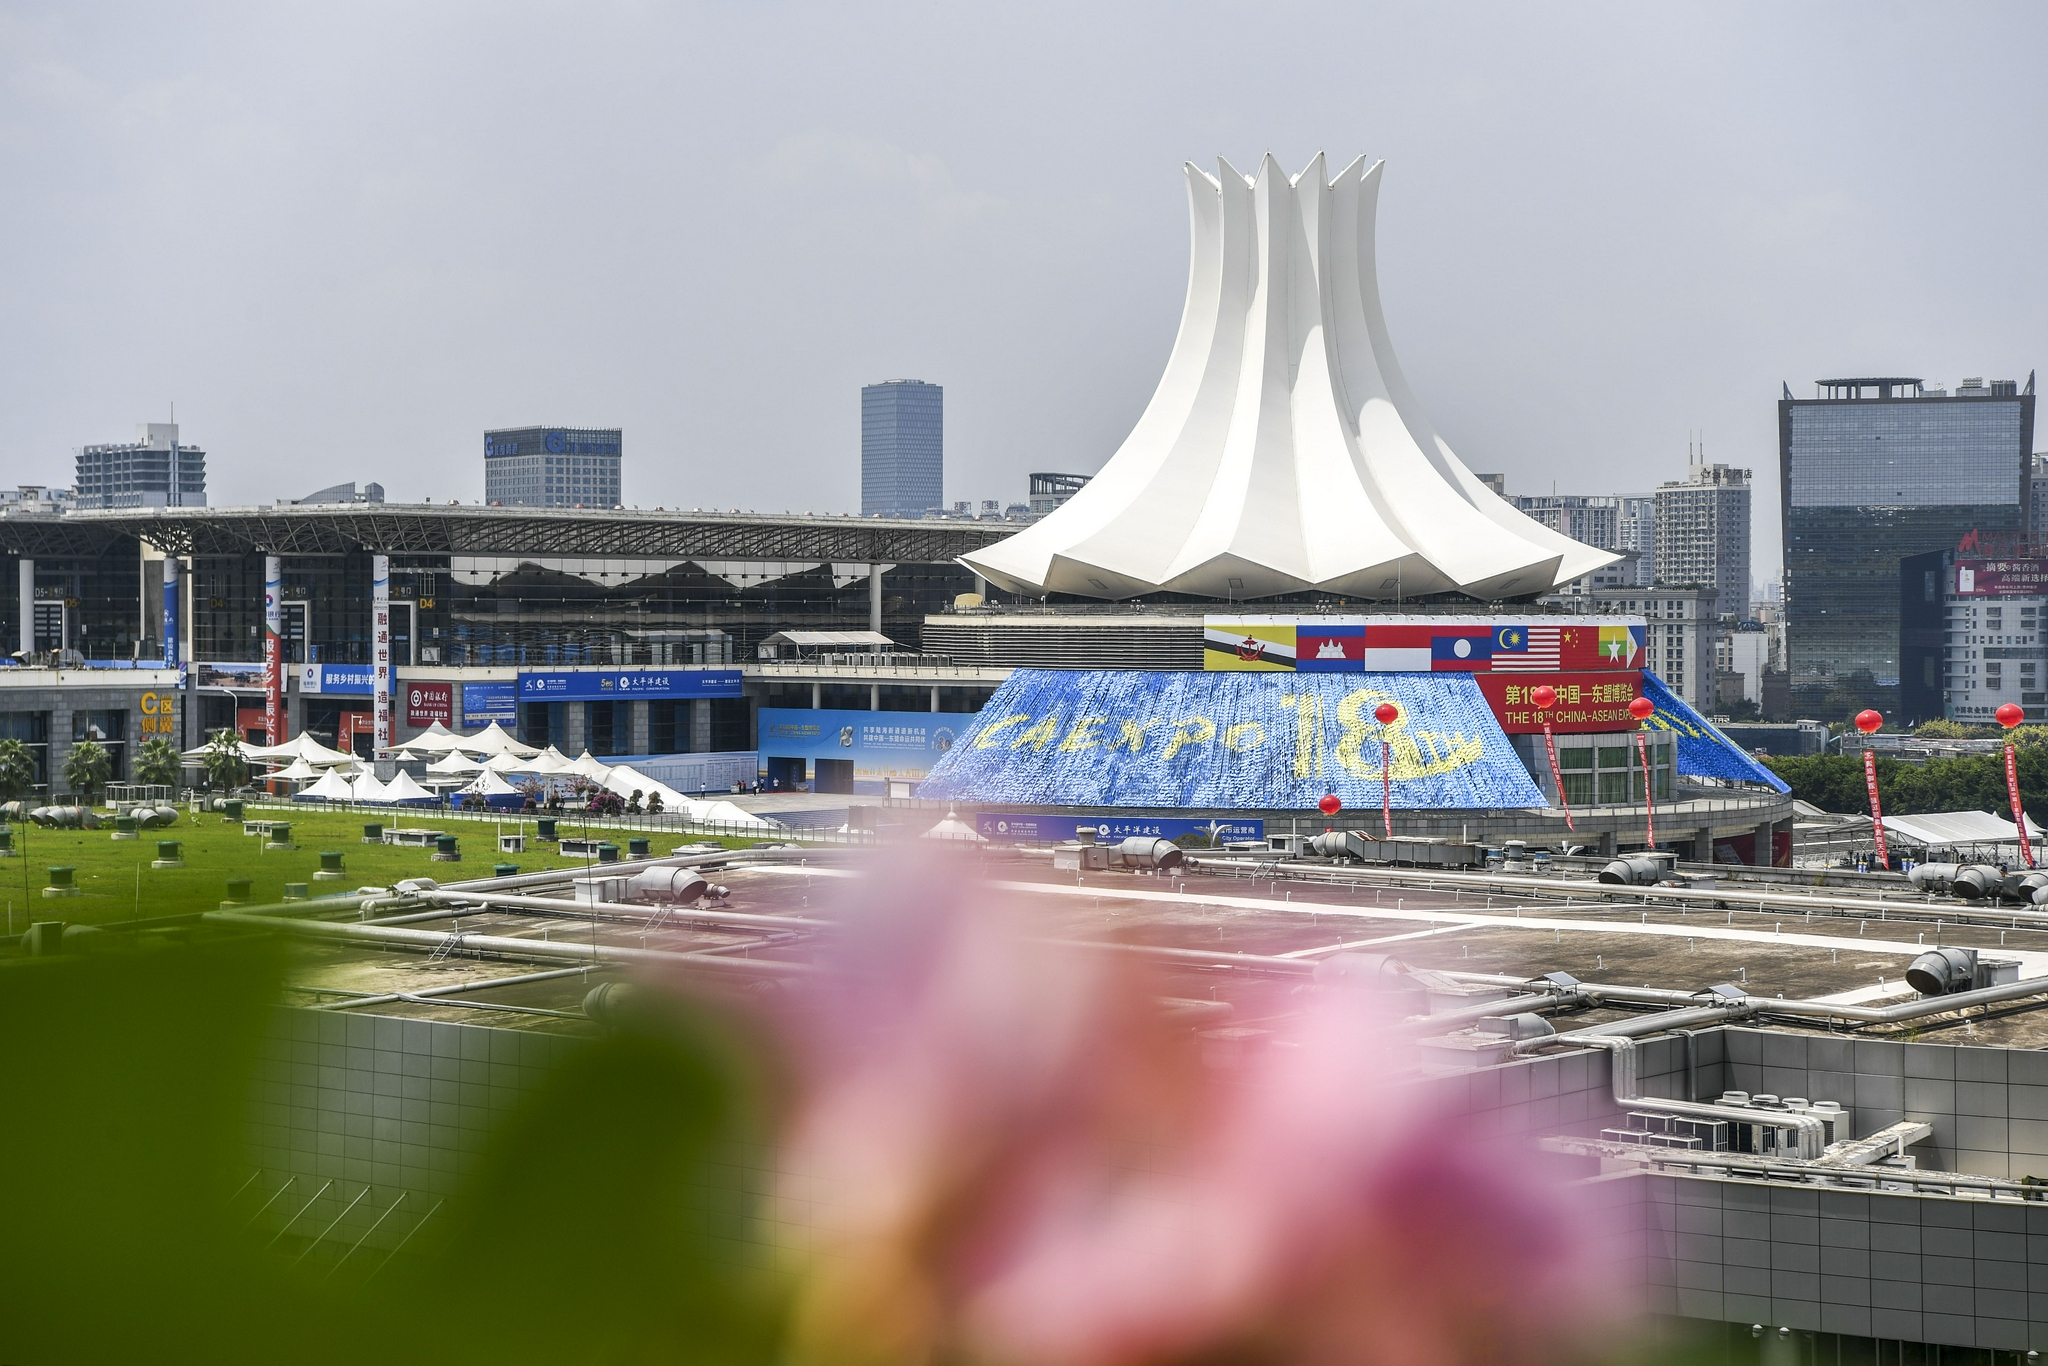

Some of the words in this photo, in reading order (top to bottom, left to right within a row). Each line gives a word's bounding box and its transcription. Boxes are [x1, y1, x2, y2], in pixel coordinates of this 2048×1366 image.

[420, 598, 433, 608] D4
[377, 612, 388, 679] 融通世界
[632, 676, 670, 686] 太平洋建设
[423, 691, 448, 702] 中国银行
[1505, 711, 1530, 724] THE
[1555, 709, 1618, 723] CHINA-ASEAN
[972, 713, 1266, 762] CAEXPO
[1113, 825, 1162, 835] 太平洋建设
